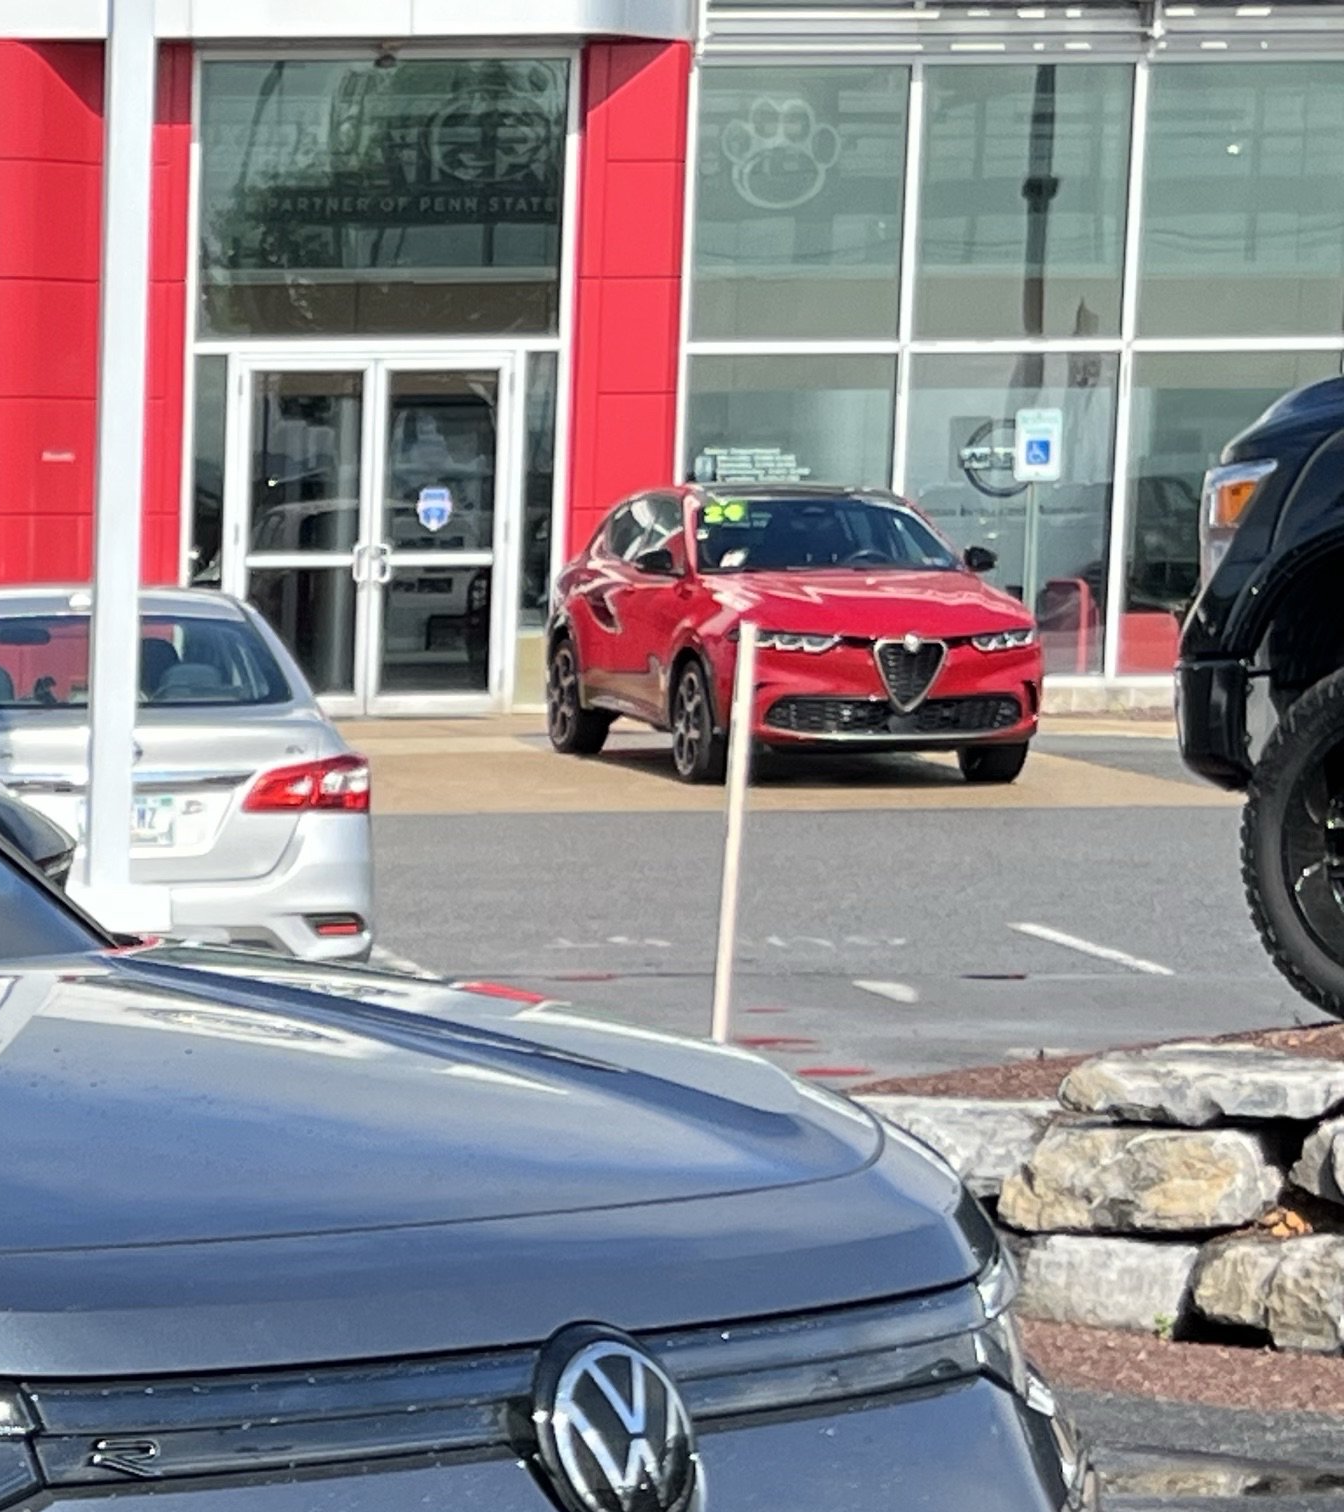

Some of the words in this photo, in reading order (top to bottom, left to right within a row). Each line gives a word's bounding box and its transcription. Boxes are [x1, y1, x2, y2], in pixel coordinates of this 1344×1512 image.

[267, 196, 370, 213] PARTNER
[379, 197, 408, 212] OF
[419, 197, 479, 212] PENN
[488, 197, 555, 212] STATE
